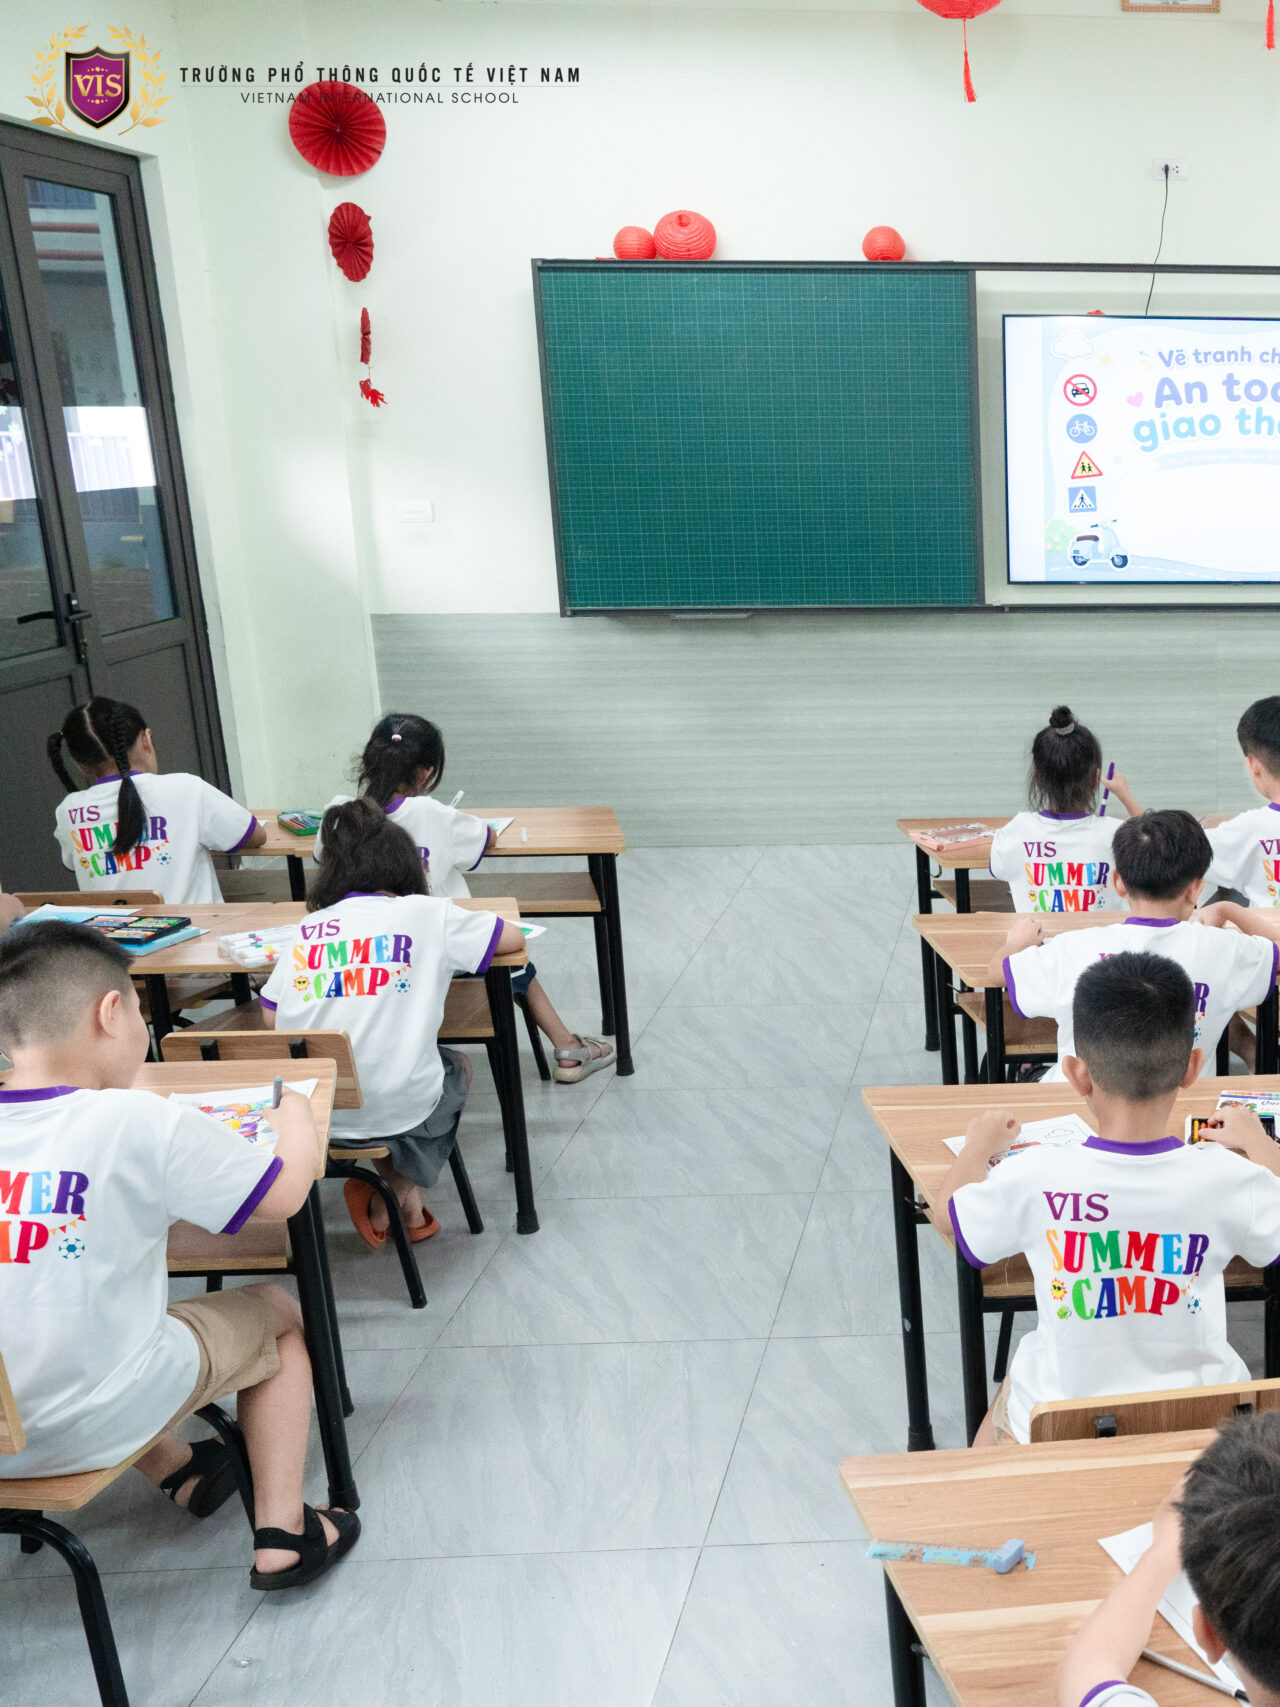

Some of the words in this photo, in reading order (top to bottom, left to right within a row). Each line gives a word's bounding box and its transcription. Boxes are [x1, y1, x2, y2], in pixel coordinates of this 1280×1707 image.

[1158, 349, 1186, 368] Vẽ
[1192, 346, 1252, 365] tranh
[1155, 376, 1208, 409] An
[1133, 411, 1222, 453] giao
[68, 805, 101, 825] VIS
[70, 816, 168, 854] SUMR
[1023, 841, 1057, 858] VIS
[90, 845, 152, 877] CAMP
[1024, 861, 1110, 887] SUMMER
[1038, 889, 1096, 913] CAMP
[300, 918, 341, 940] VIS
[292, 934, 413, 972] SUMMER
[313, 967, 390, 1000] CAMP
[1043, 1191, 1110, 1223] VIS
[1045, 1229, 1210, 1276] SUMMER
[1071, 1275, 1181, 1321] CAMP
